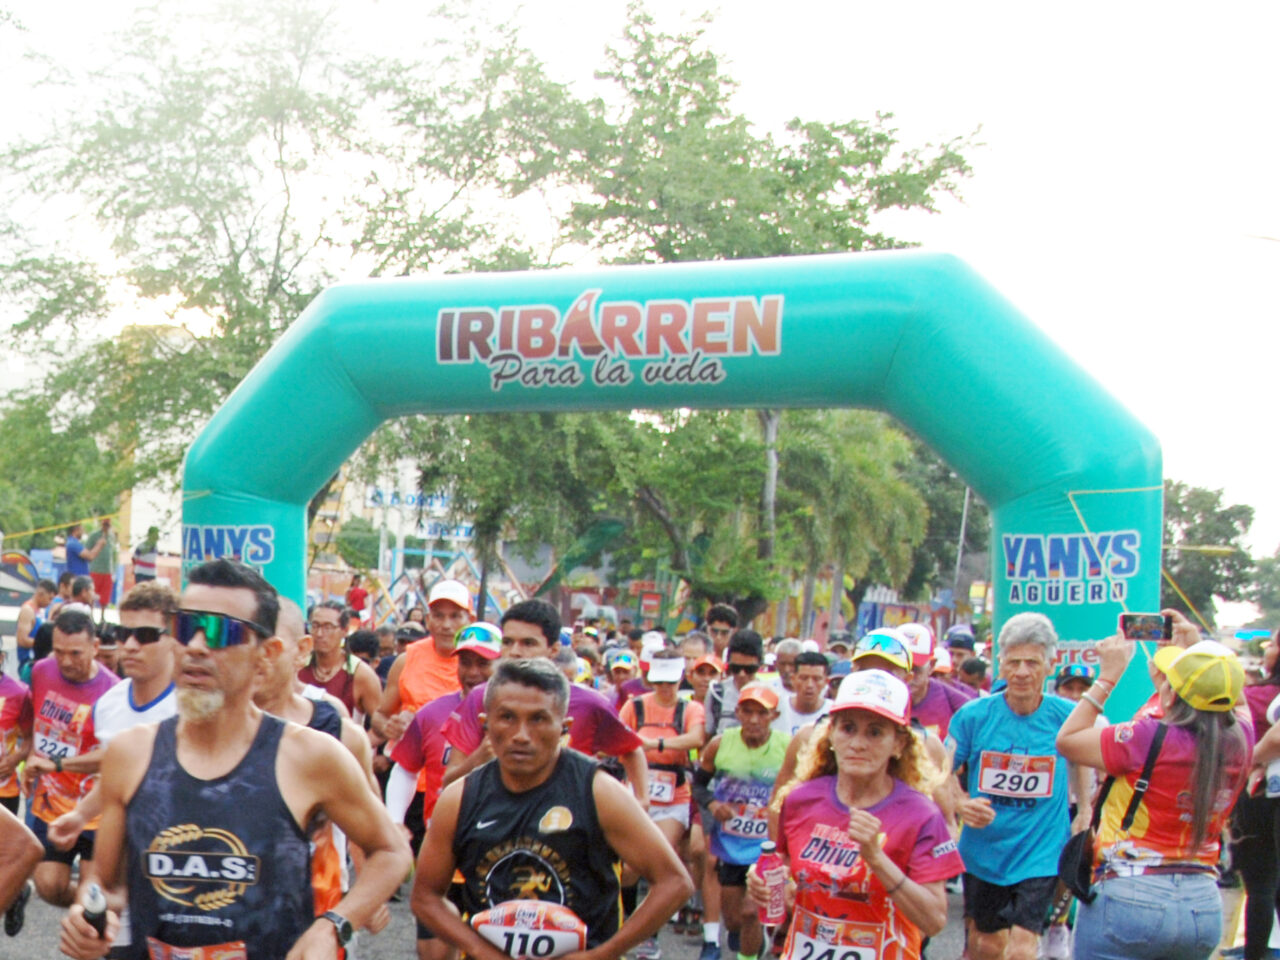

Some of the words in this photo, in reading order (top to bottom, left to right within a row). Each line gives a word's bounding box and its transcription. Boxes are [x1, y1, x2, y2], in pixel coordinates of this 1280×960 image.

[438, 289, 782, 362] IRIBARREN
[490, 352, 580, 391] Para
[594, 353, 631, 385] la
[644, 351, 722, 384] vida
[1003, 533, 1139, 579] YANYS
[1010, 580, 1125, 602] AGÜERO
[41, 699, 74, 725] Chivo
[39, 739, 69, 758] 224
[991, 773, 1039, 792] 290
[731, 818, 767, 836] 280
[800, 836, 859, 868] Chivo
[503, 931, 556, 958] 110
